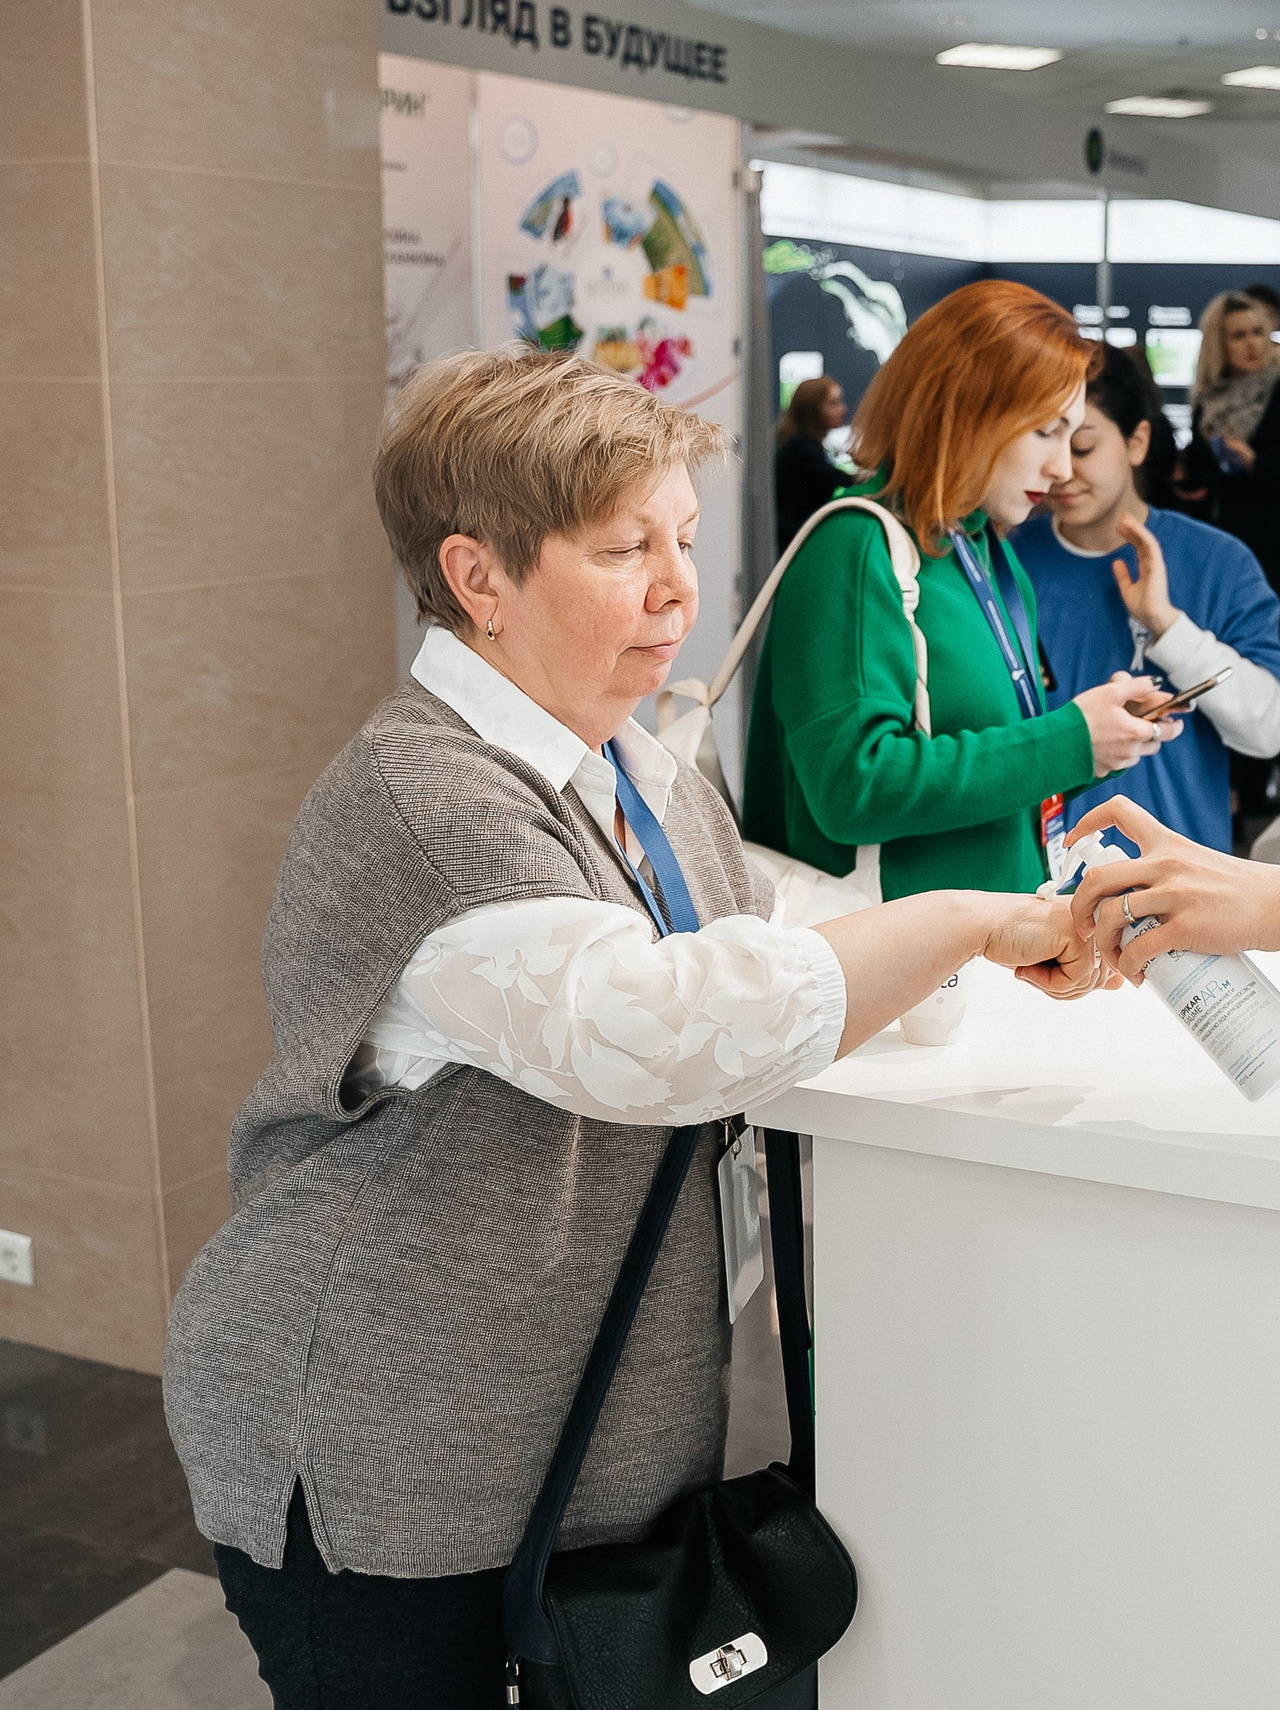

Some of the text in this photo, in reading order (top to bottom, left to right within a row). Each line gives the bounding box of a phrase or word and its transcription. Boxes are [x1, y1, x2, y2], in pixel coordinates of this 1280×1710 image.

[551, 7, 571, 48] В
[583, 14, 727, 83] БУДУЩЕЕ
[1177, 994, 1201, 1019] LIPIKAR
